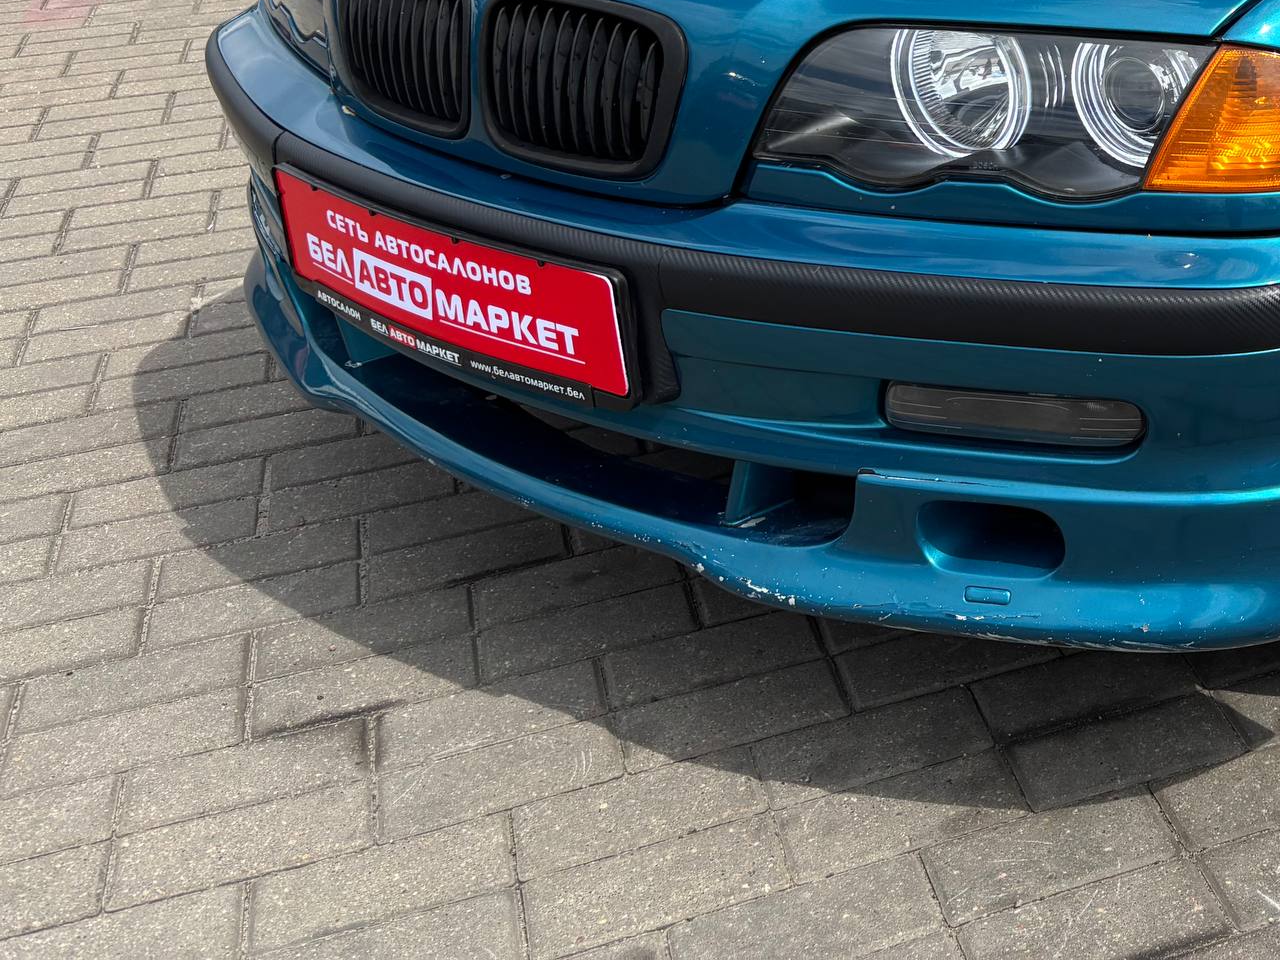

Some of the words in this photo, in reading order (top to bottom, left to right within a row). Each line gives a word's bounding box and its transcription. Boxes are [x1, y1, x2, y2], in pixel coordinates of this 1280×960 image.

[326, 209, 369, 243] СЕТЬ
[375, 230, 532, 295] АВТОСАЛОНОВ
[317, 290, 361, 321] АВТОСАЛОН
[470, 360, 586, 401] www.белавтомаркет.бел
